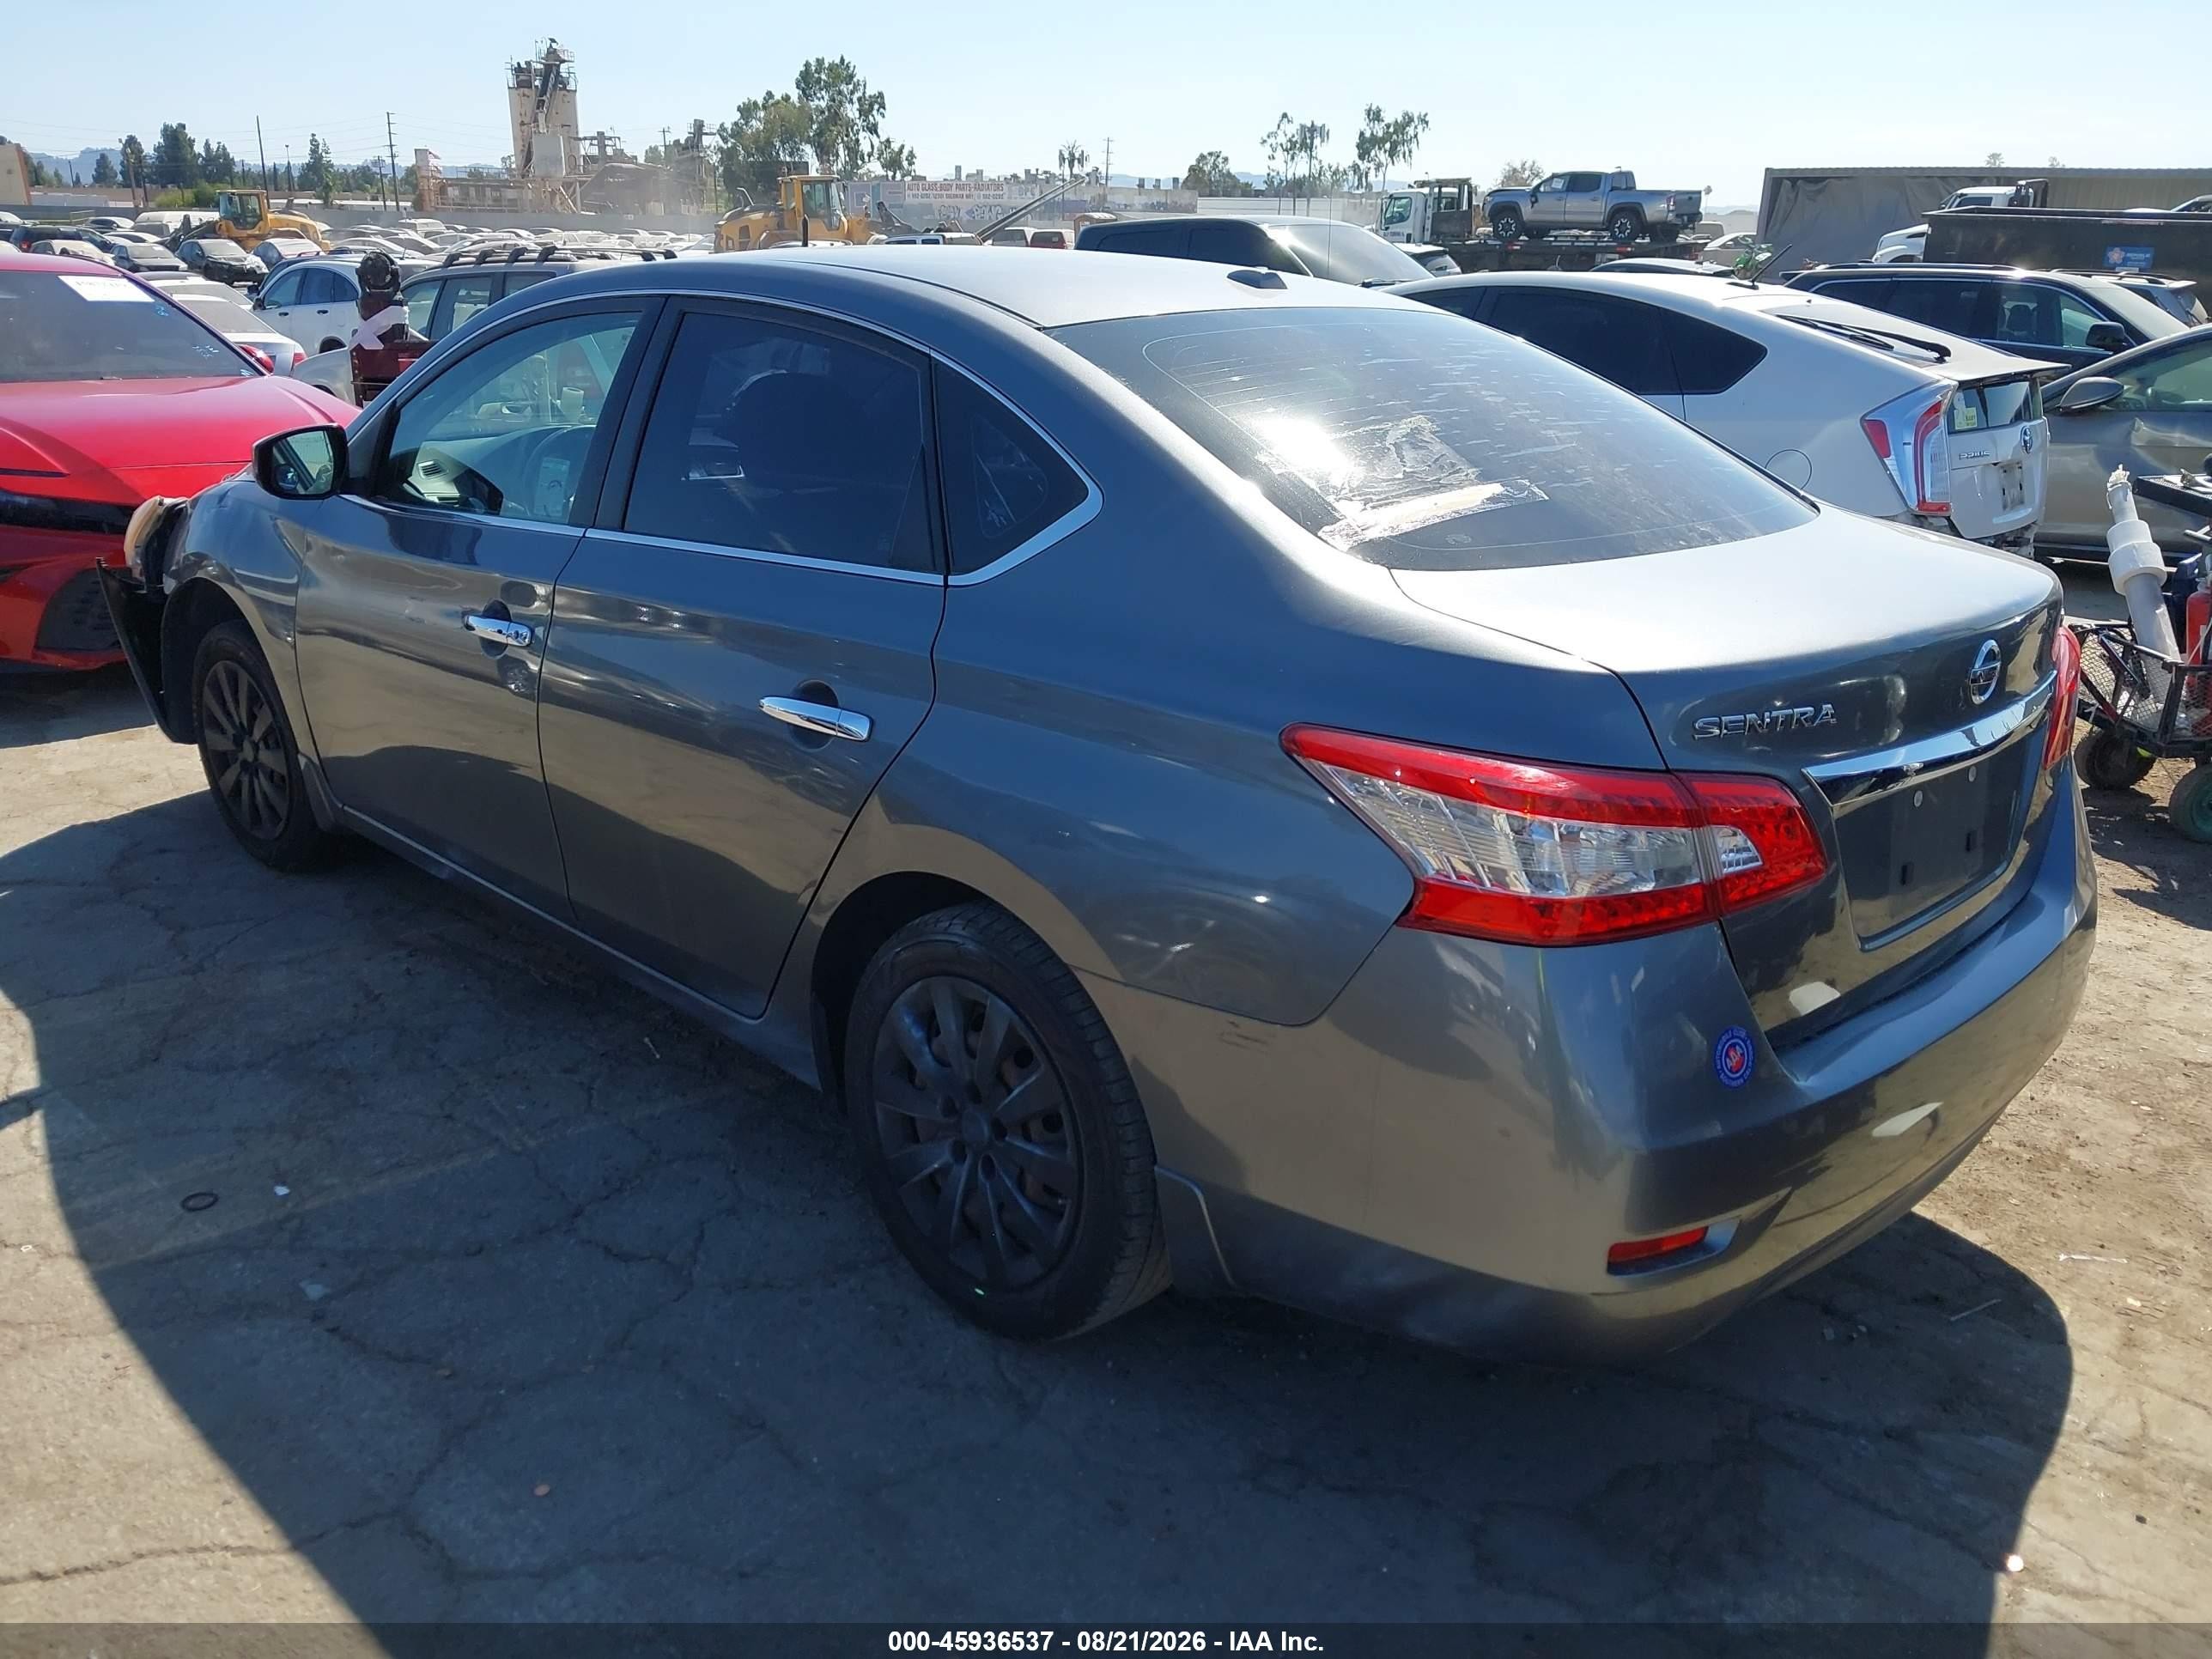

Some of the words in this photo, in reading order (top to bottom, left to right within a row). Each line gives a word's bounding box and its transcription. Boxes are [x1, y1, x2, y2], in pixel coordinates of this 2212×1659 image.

[907, 183, 920, 191] AUTO
[1692, 703, 1837, 740] SENTRA
[1726, 1043, 1744, 1071] AAA
